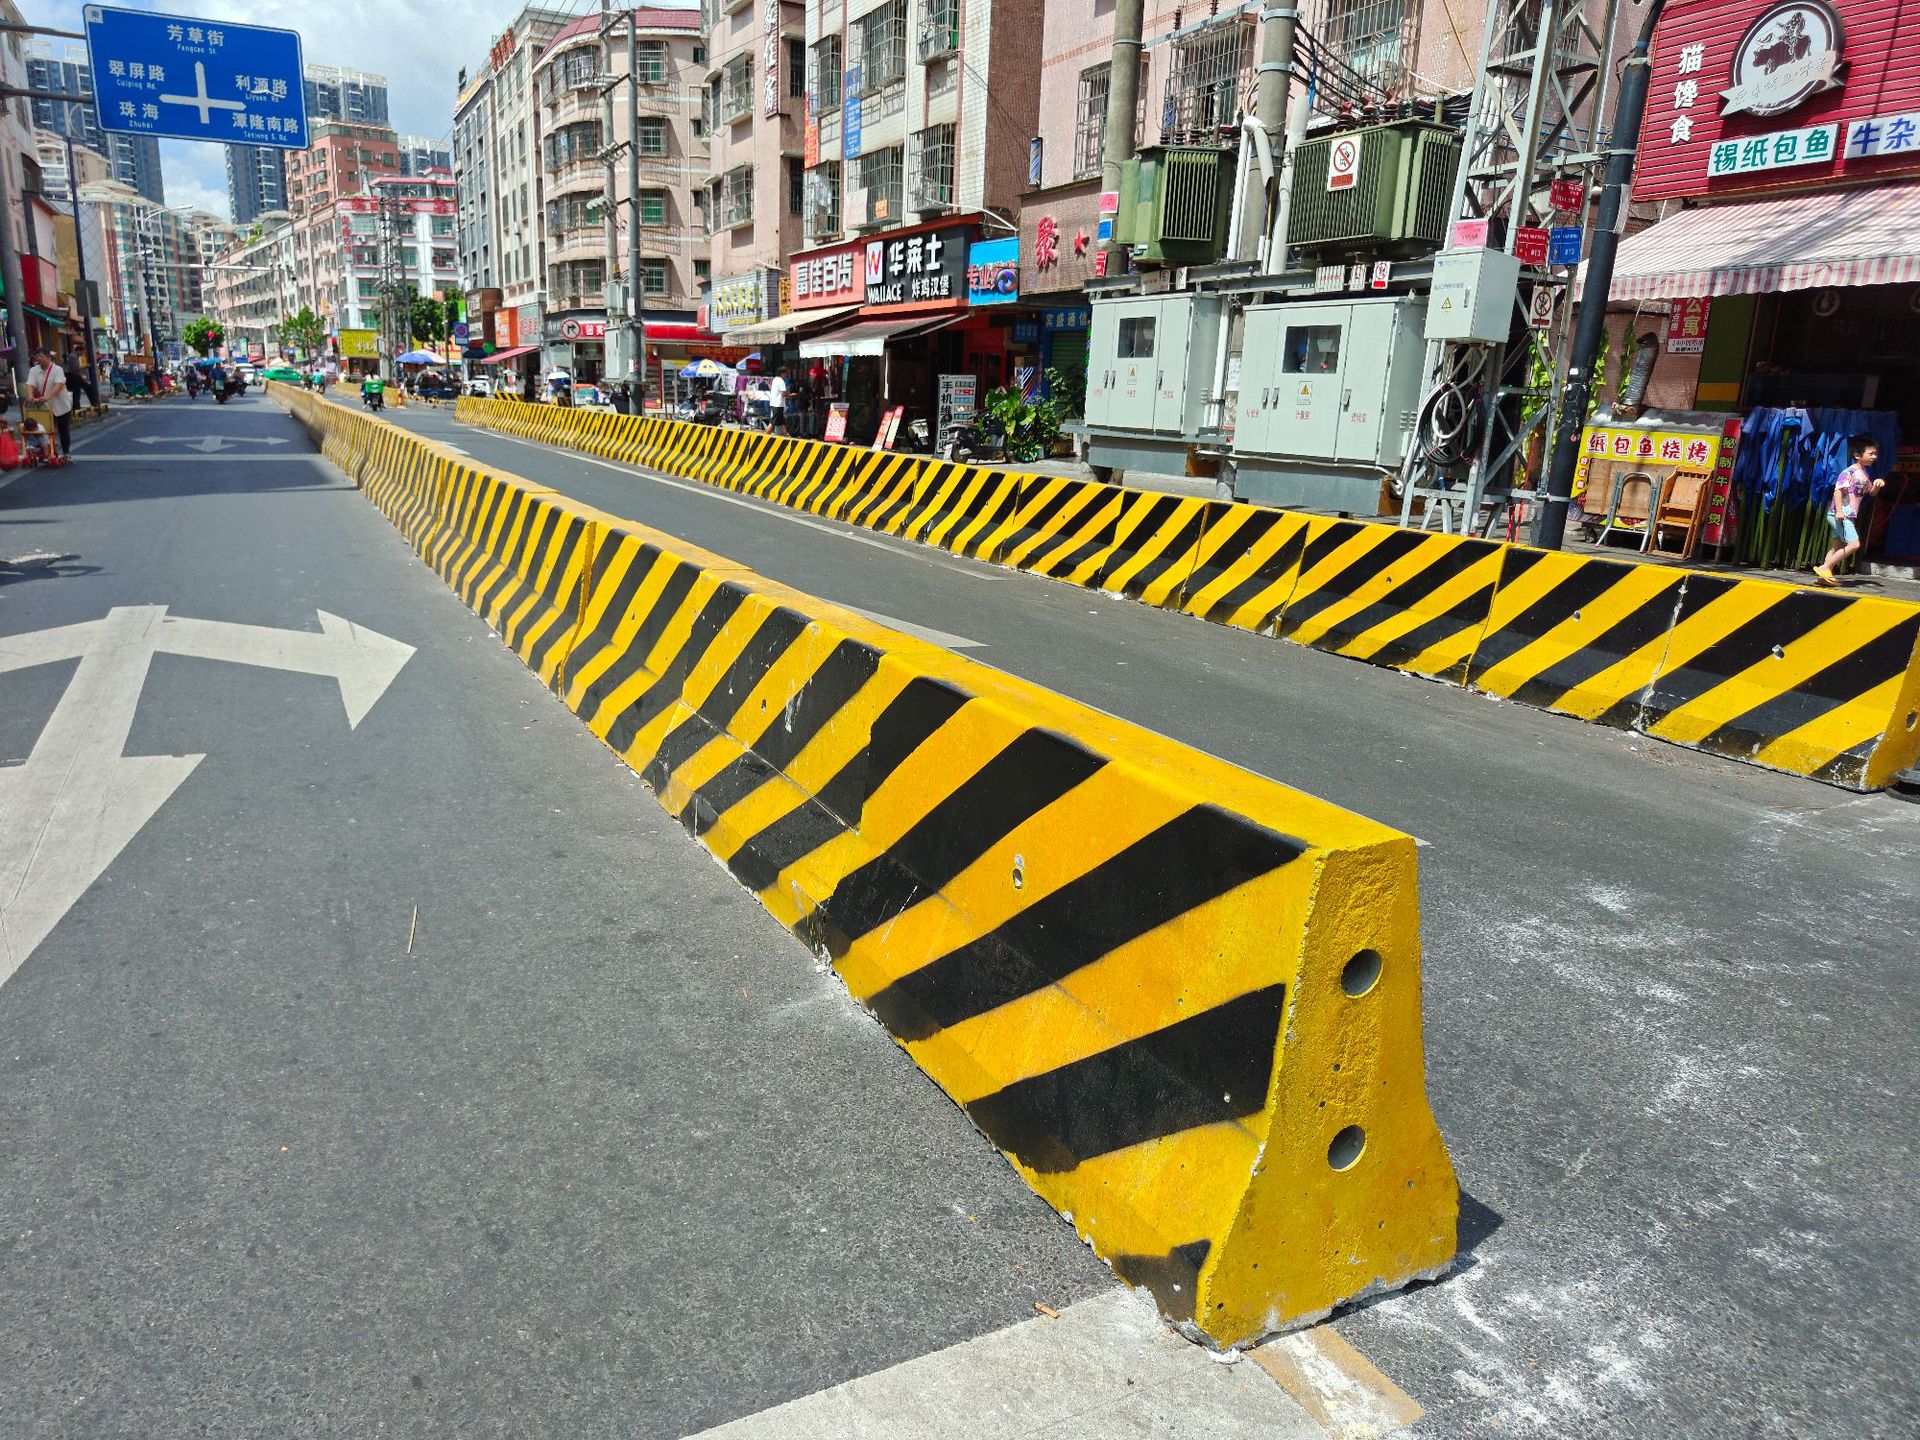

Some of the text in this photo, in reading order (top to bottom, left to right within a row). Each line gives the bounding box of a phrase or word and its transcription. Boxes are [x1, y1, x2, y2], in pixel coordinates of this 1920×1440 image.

[166, 24, 224, 46] 芳草街
[108, 60, 165, 82] 翠屏路
[235, 75, 287, 96] 利源路
[119, 101, 159, 120] 珠海
[1670, 43, 1705, 144] 猫馋食
[1713, 129, 1830, 173] 锡纸包鱼
[1852, 118, 1920, 155] 牛杂
[889, 233, 942, 276] 华莱士
[796, 253, 853, 295] 富佳百货
[912, 275, 949, 298] 炸鸡汉堡
[1682, 298, 1702, 336] 公寓
[1588, 433, 1711, 463] 纸包鱼烧烤
[1708, 437, 1736, 526] 秘制牛杂煲
